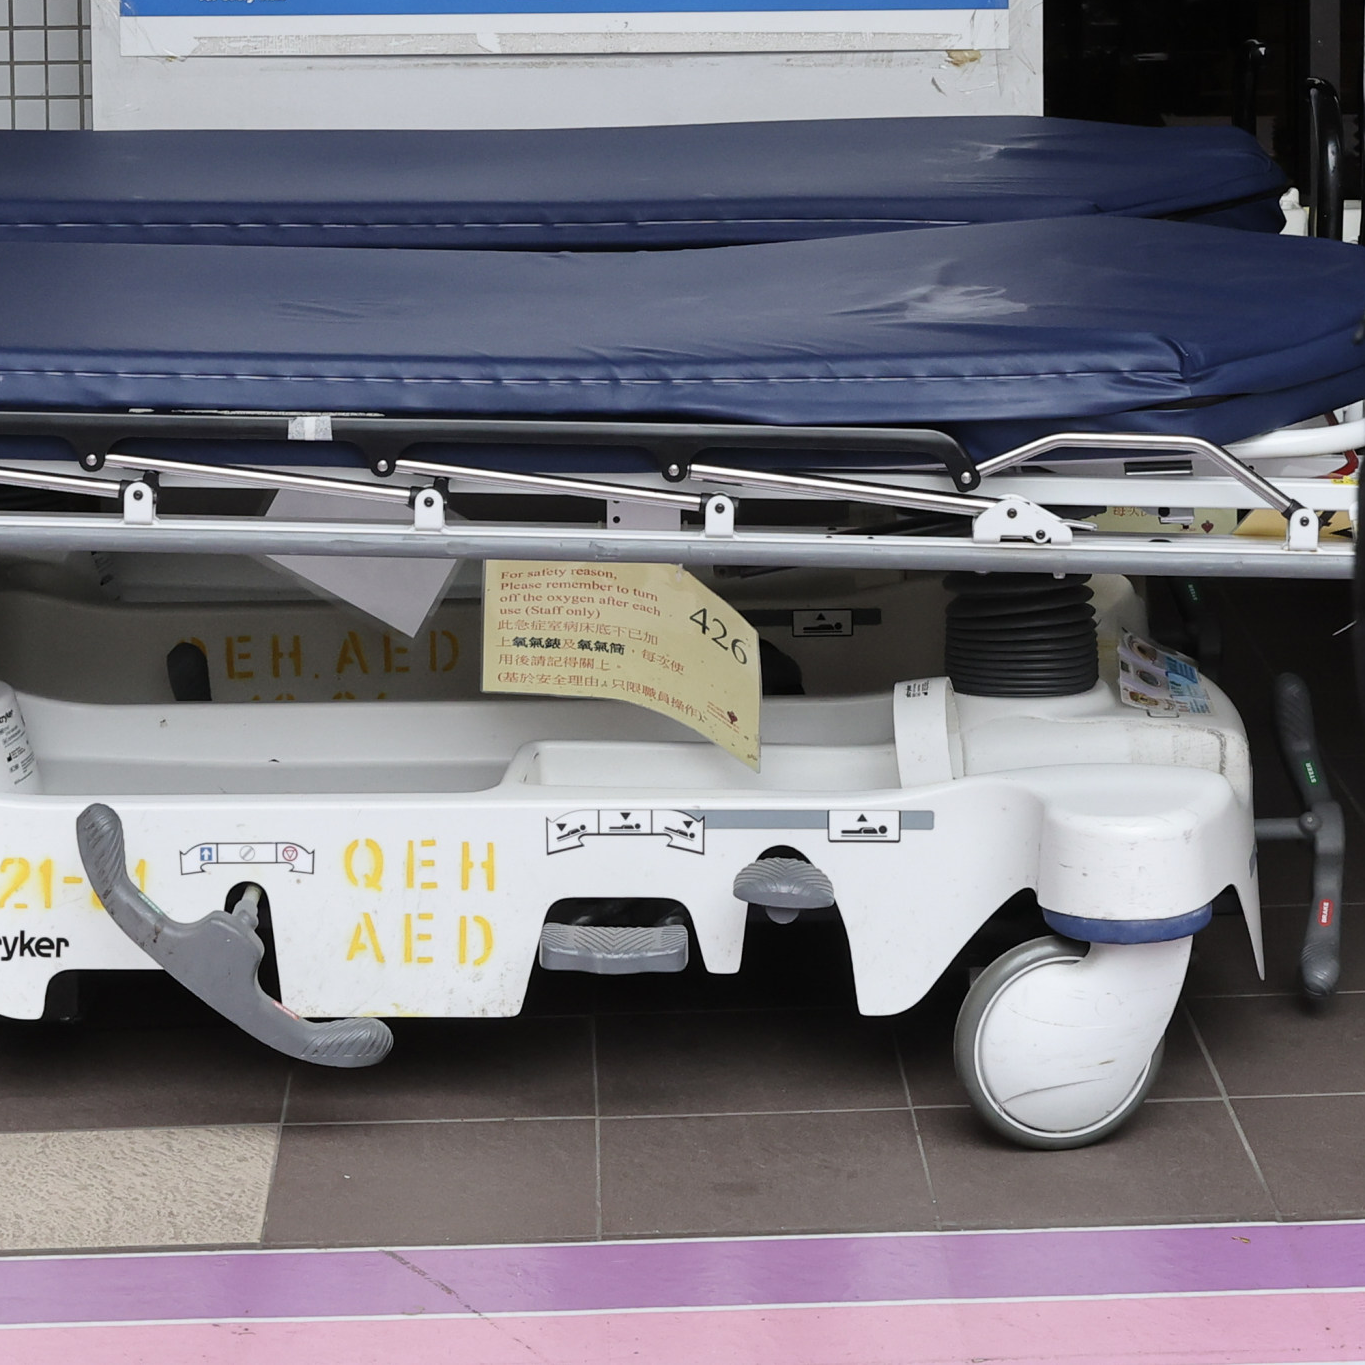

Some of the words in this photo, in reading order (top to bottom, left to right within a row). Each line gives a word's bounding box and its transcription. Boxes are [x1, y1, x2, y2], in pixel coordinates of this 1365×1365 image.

[501, 571, 523, 579] For
[527, 568, 566, 578] safety
[570, 568, 617, 580] reason,
[500, 582, 541, 590] Please
[546, 581, 613, 591] remember
[617, 585, 629, 594] to
[633, 588, 658, 602] turn
[500, 594, 522, 602] off
[523, 593, 543, 602] the
[547, 595, 595, 605] oxygen
[599, 597, 629, 608] after
[633, 604, 661, 617] each
[525, 605, 563, 616] (Staff
[566, 607, 601, 619] only)
[689, 607, 747, 665] 426
[1305, 763, 1316, 783] STEER
[342, 837, 497, 893] QEH
[1321, 902, 1329, 924] BRAKE
[345, 910, 496, 967] AED
